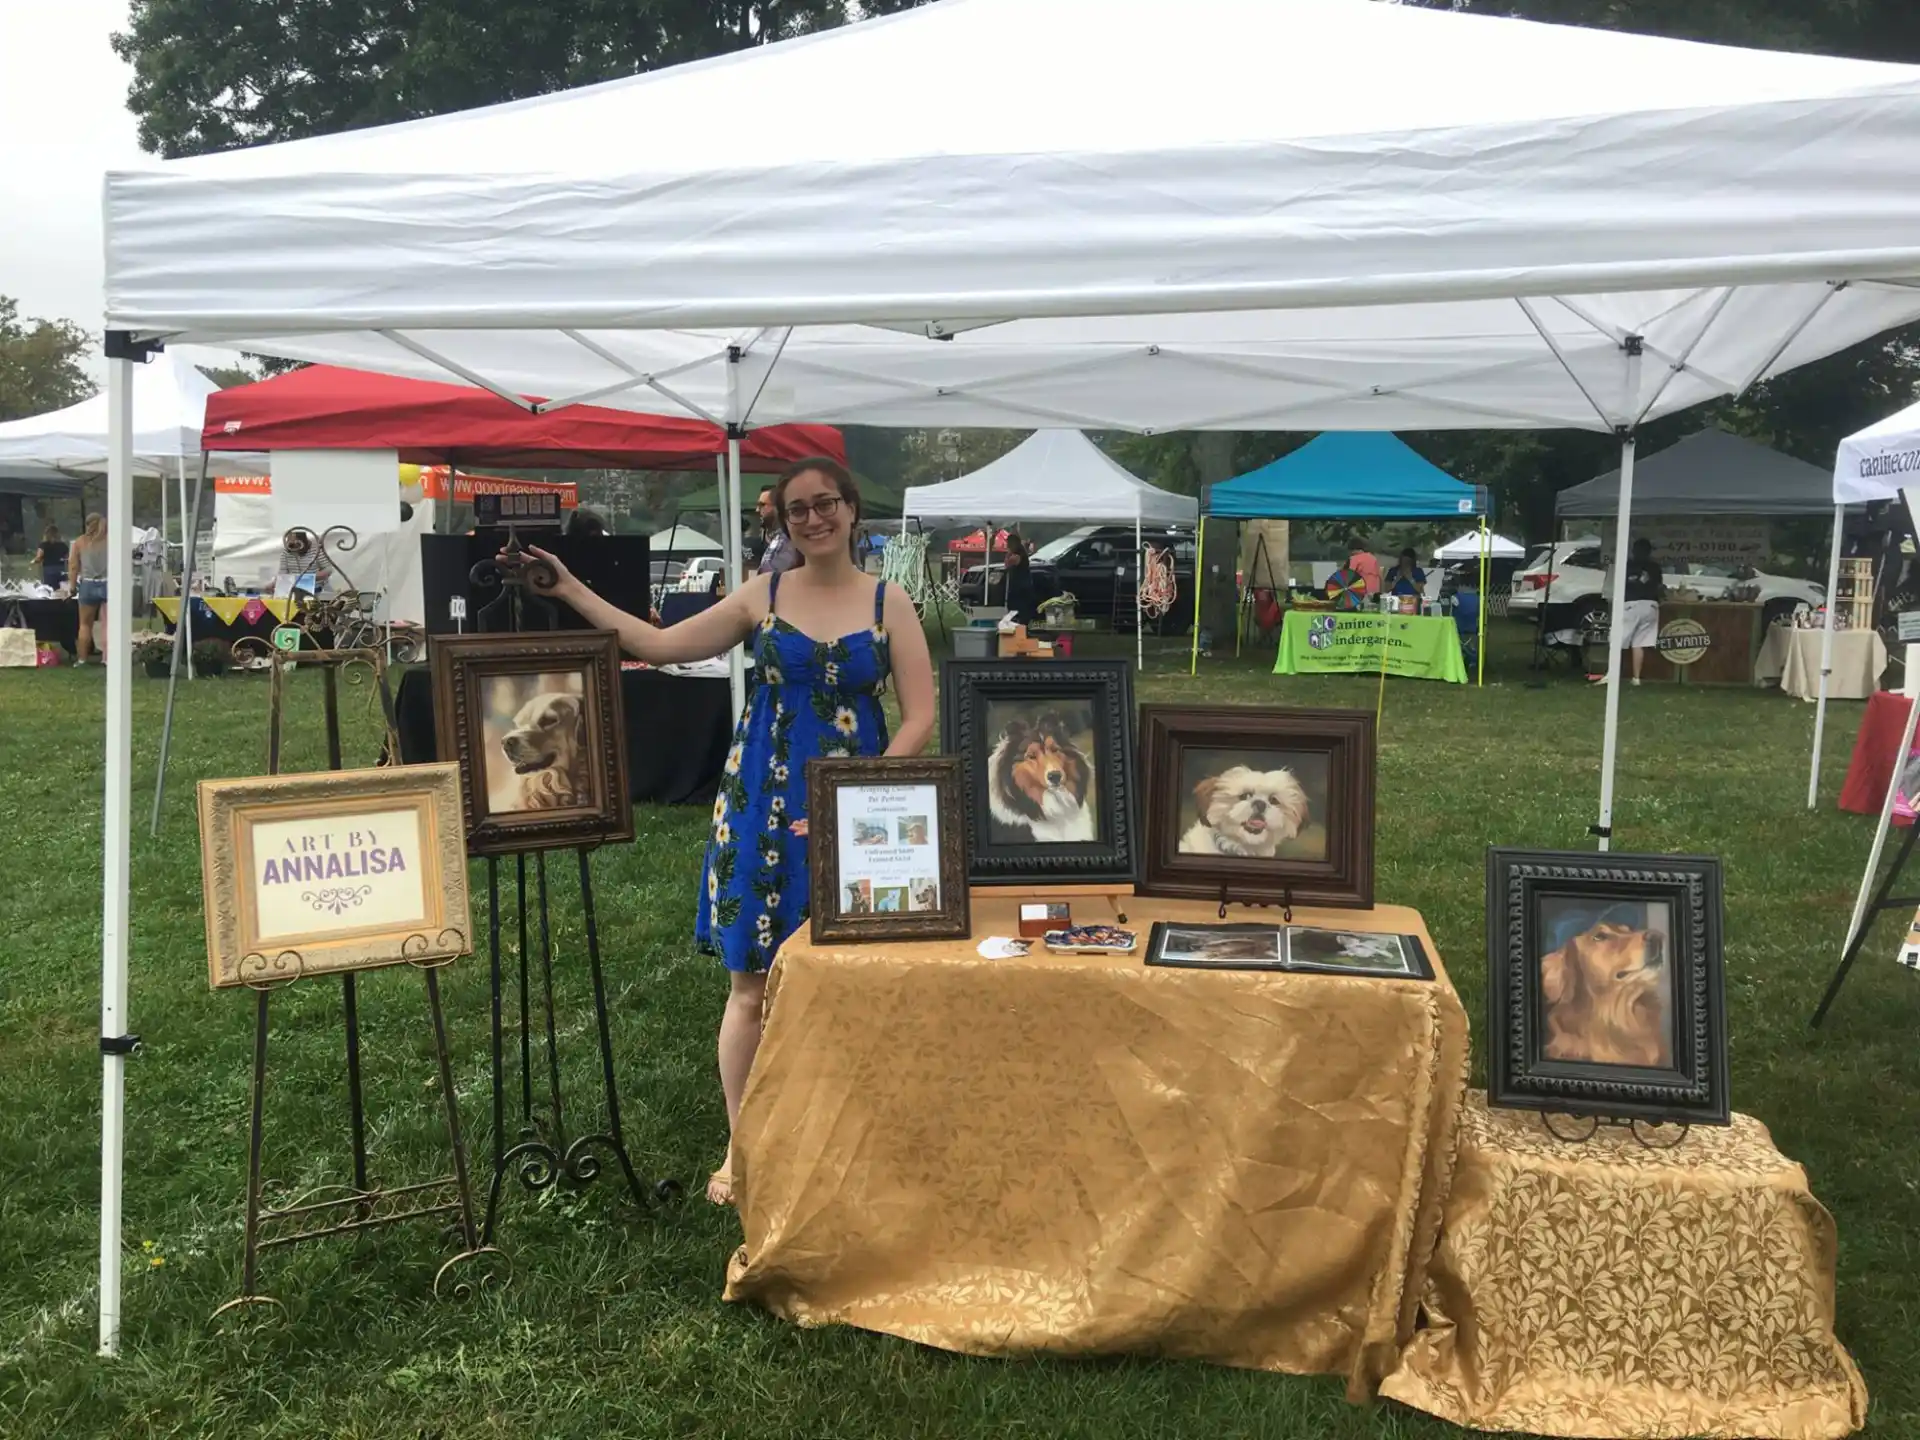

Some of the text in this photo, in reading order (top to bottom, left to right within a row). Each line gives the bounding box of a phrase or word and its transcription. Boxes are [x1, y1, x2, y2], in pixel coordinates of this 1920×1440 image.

[281, 829, 381, 854] ART BY
[263, 847, 406, 885] ANNALISA
